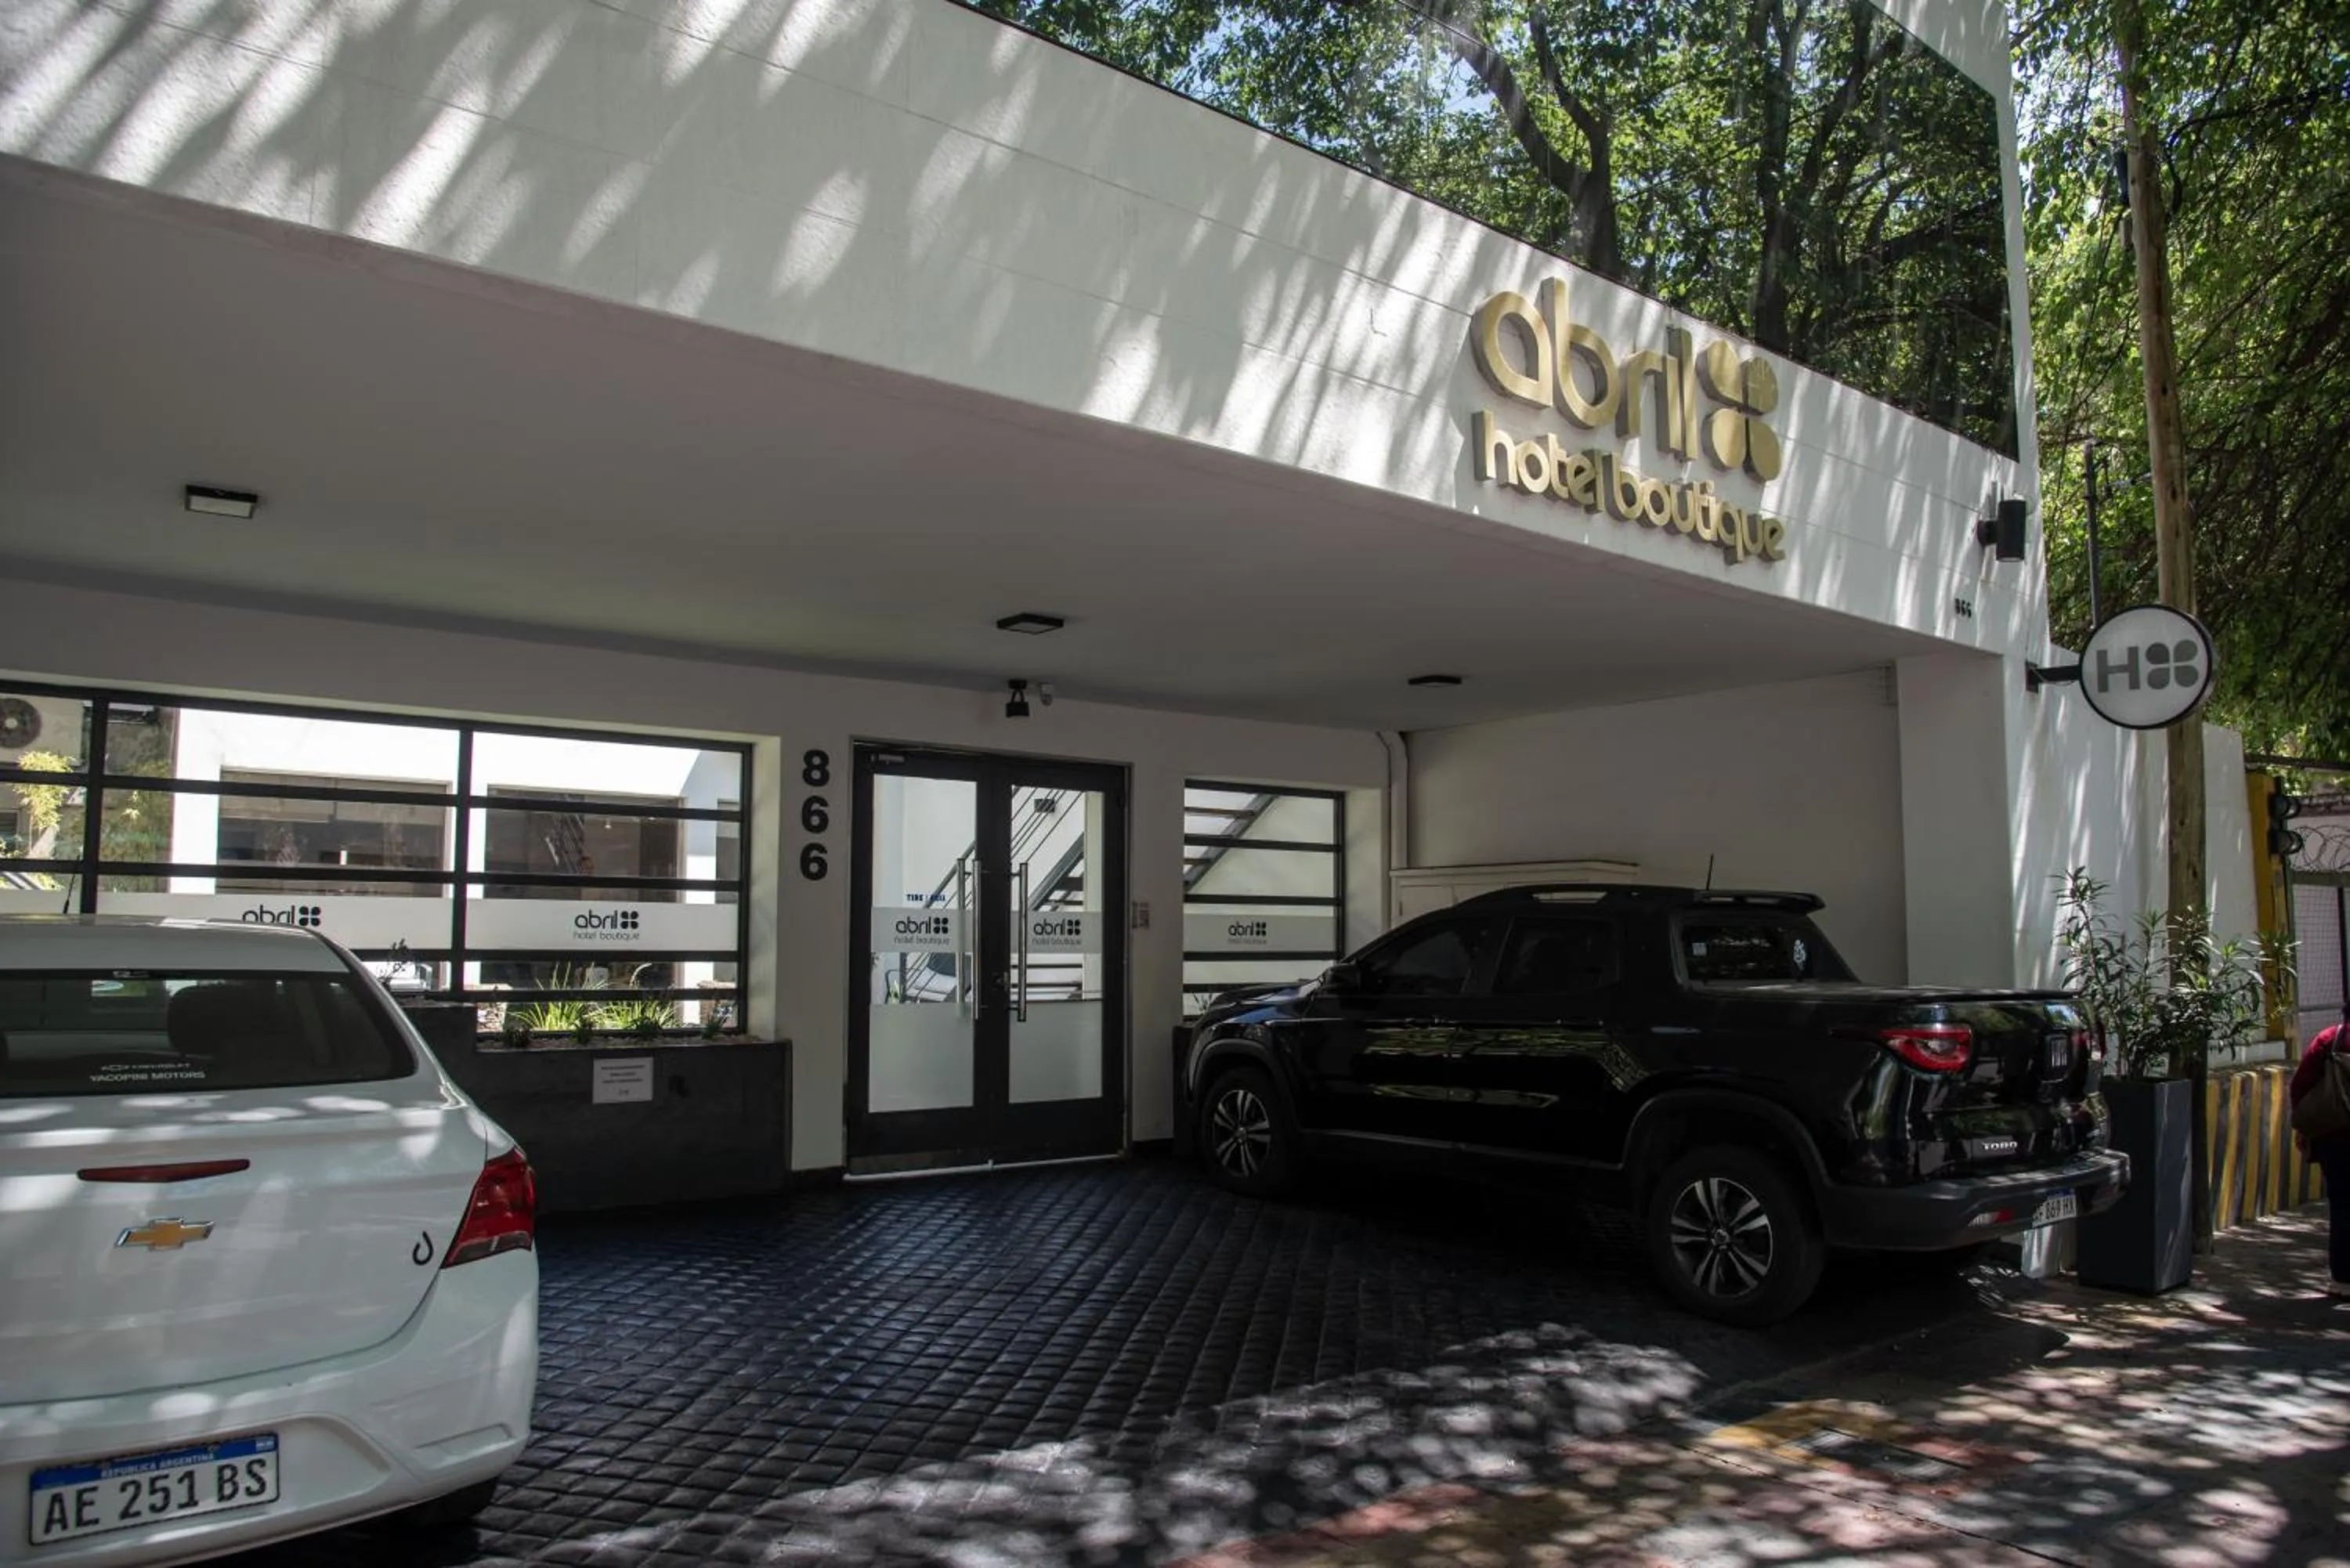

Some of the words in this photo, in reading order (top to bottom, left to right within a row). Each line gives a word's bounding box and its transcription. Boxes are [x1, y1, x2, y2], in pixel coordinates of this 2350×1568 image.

[1470, 276, 1698, 462] abril
[1472, 408, 1604, 514] hotel
[1602, 450, 1786, 565] boutique
[2096, 645, 2140, 693] H
[800, 749, 830, 881] 866
[574, 909, 618, 929] abril
[895, 916, 931, 934] abril
[1033, 918, 1066, 936] abril
[1227, 921, 1254, 936] abril
[151, 1070, 206, 1080] MOTORS
[44, 1486, 100, 1535] AE
[119, 1470, 200, 1521] 251
[217, 1458, 268, 1503] BS
